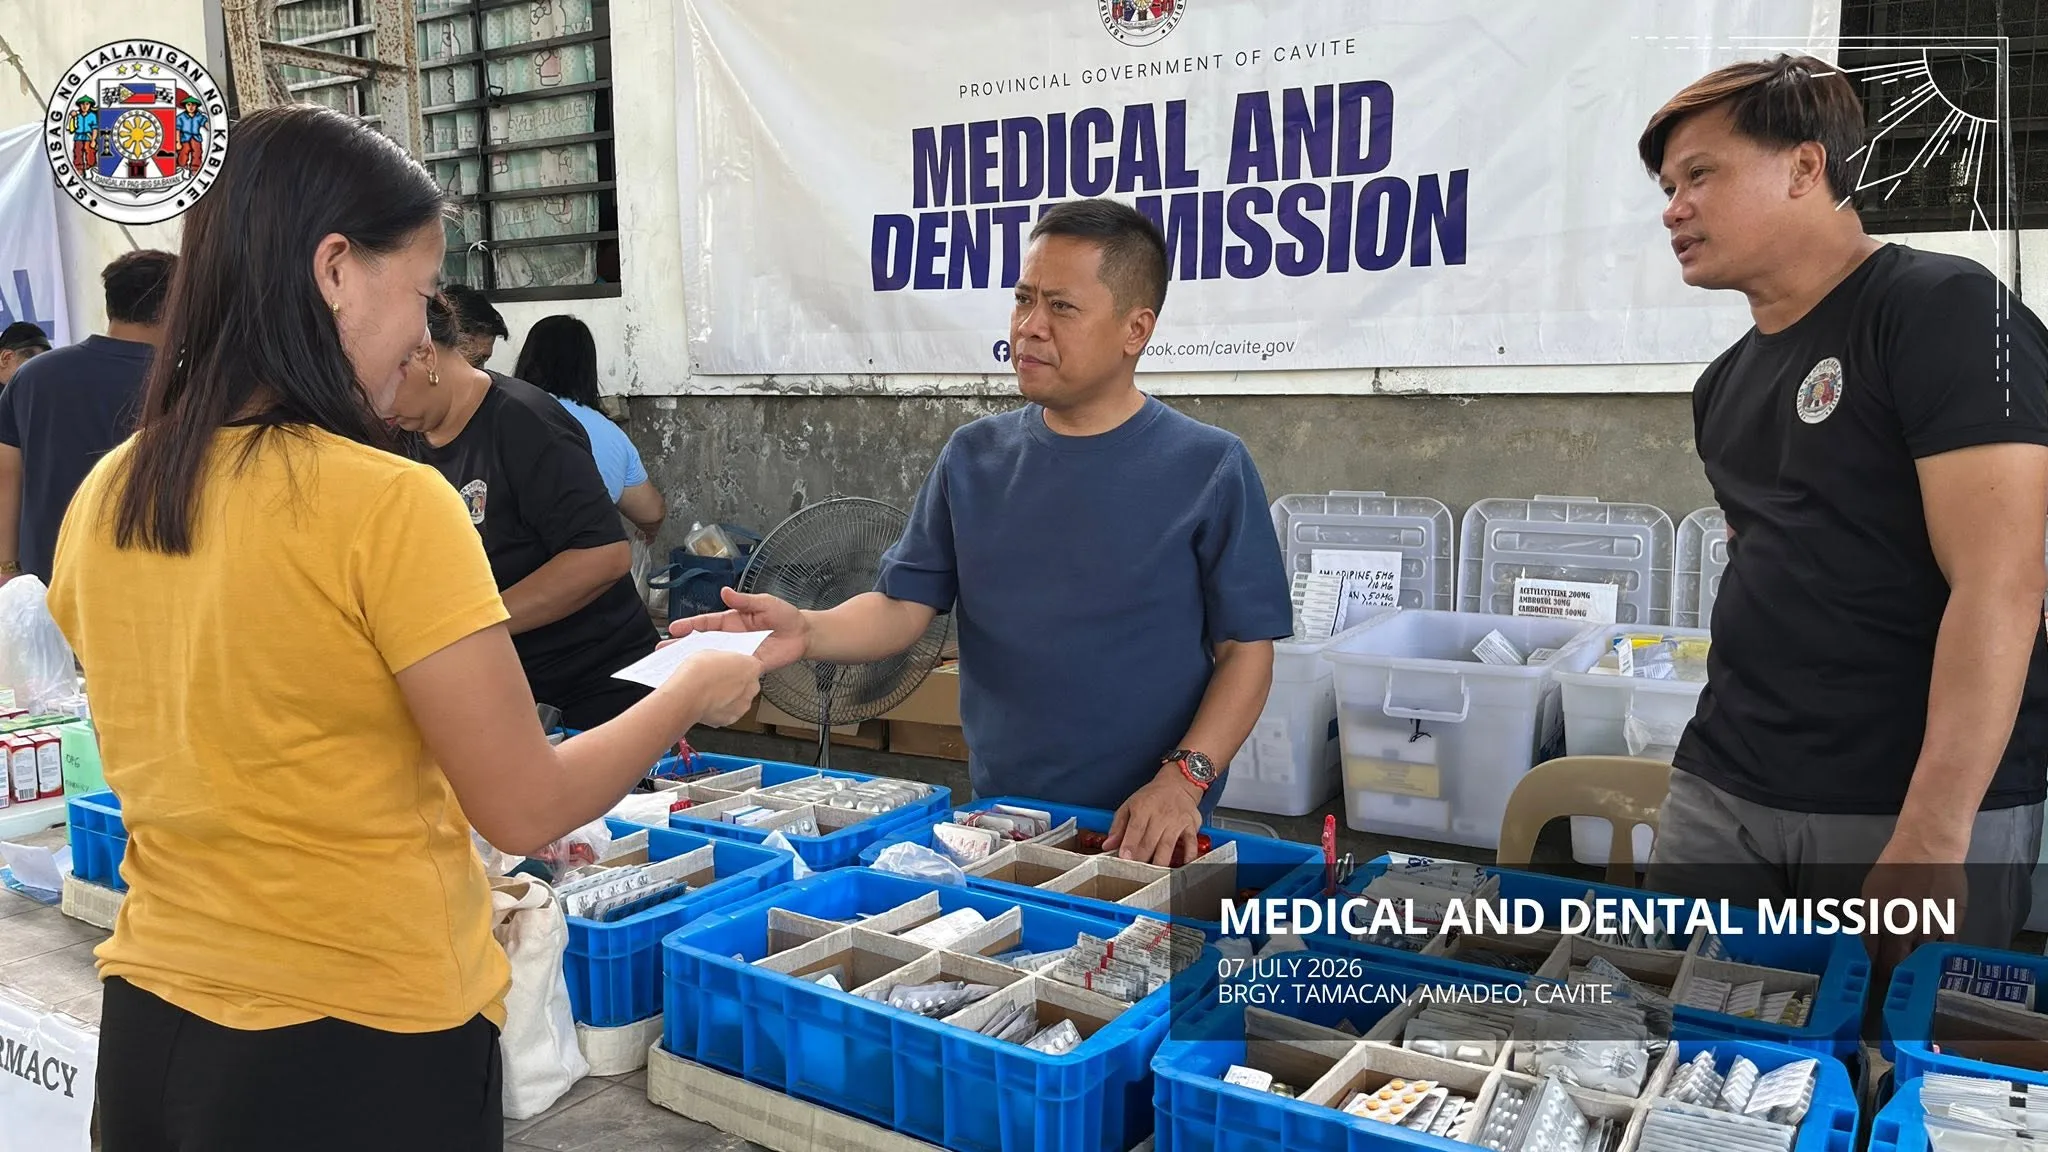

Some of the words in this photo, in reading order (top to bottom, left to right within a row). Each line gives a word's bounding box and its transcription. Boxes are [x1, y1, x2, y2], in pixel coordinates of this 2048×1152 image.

[959, 72, 1071, 98] PROVINCIAL
[1082, 54, 1223, 84] GOVERNMENT
[1235, 49, 1261, 67] OF
[1274, 38, 1356, 62] CAVITE
[912, 99, 1199, 208] MEDICAL
[1226, 79, 1394, 185] AND
[871, 205, 1052, 292] DENT
[1136, 168, 1470, 281] MISSION
[1568, 590, 1592, 599] 200MG
[0, 1034, 78, 1099] MACY
